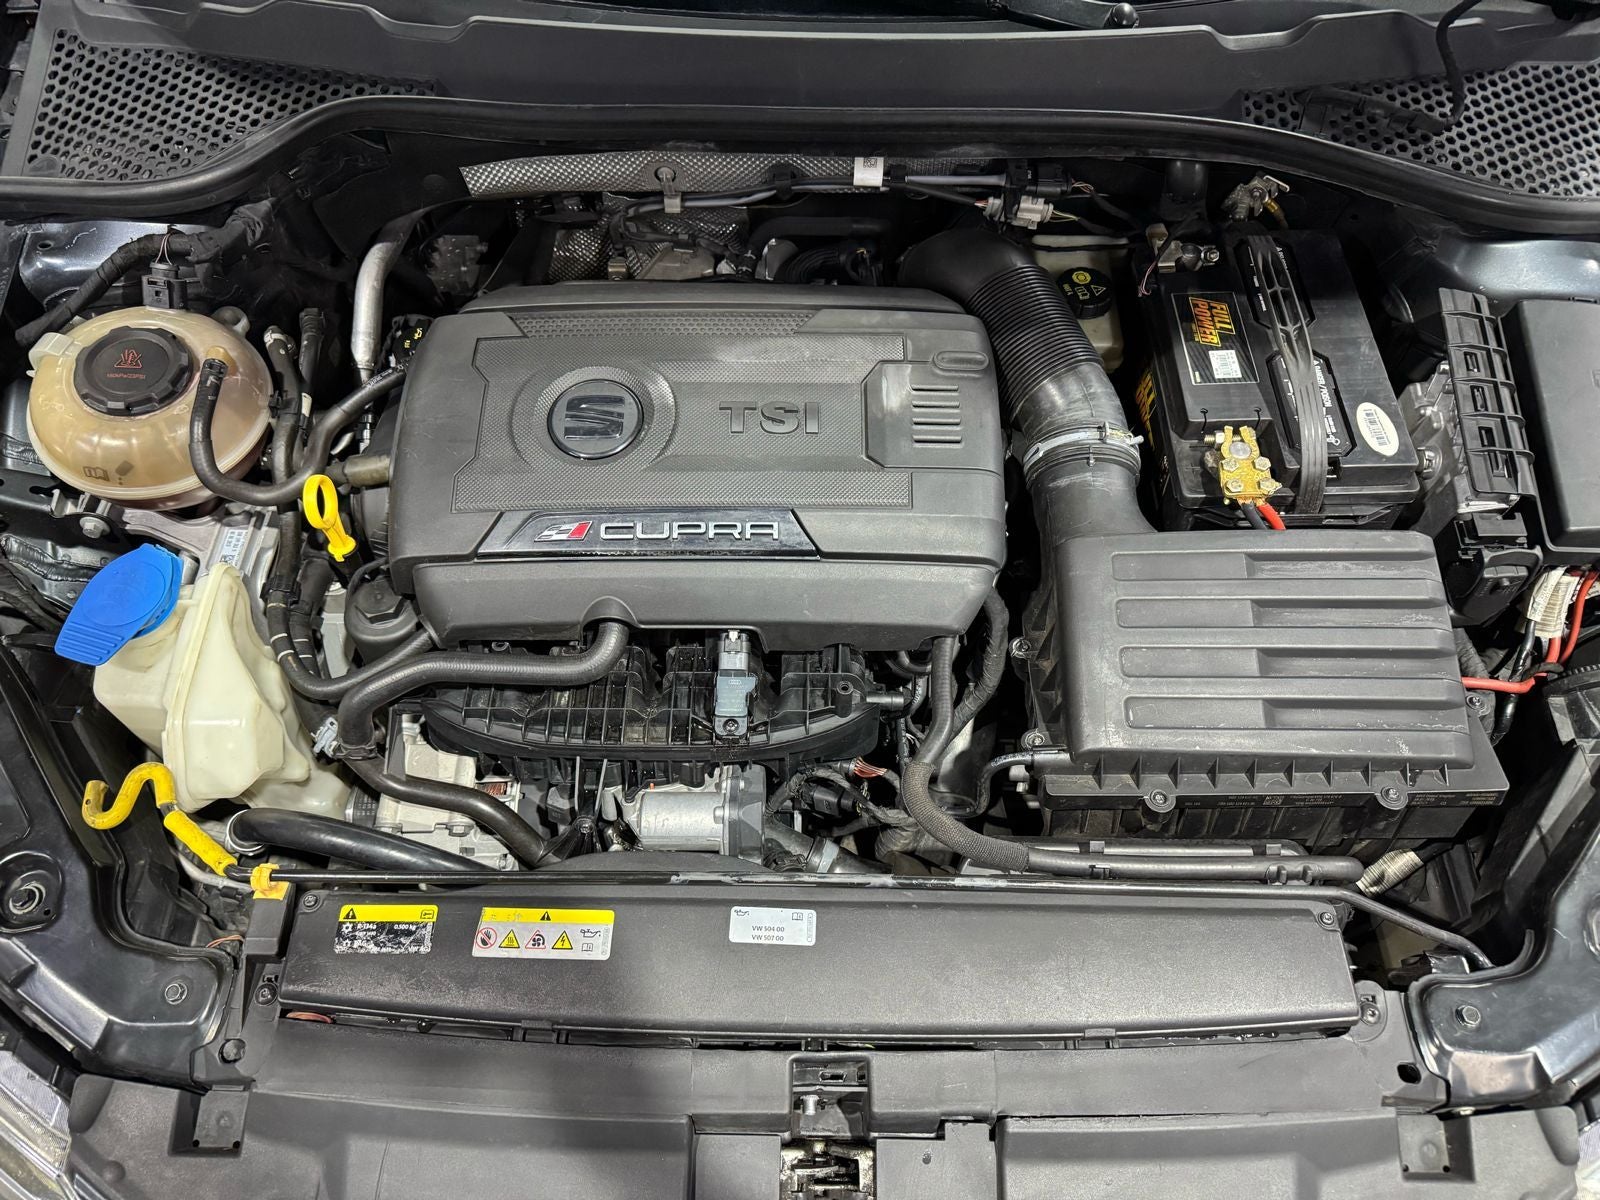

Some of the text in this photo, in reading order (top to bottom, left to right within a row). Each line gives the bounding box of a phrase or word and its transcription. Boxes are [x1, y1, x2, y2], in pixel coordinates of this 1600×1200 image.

[1191, 300, 1218, 343] POWER
[1210, 302, 1232, 329] FULL
[718, 401, 820, 435] TSI
[600, 521, 779, 540] CUPRA
